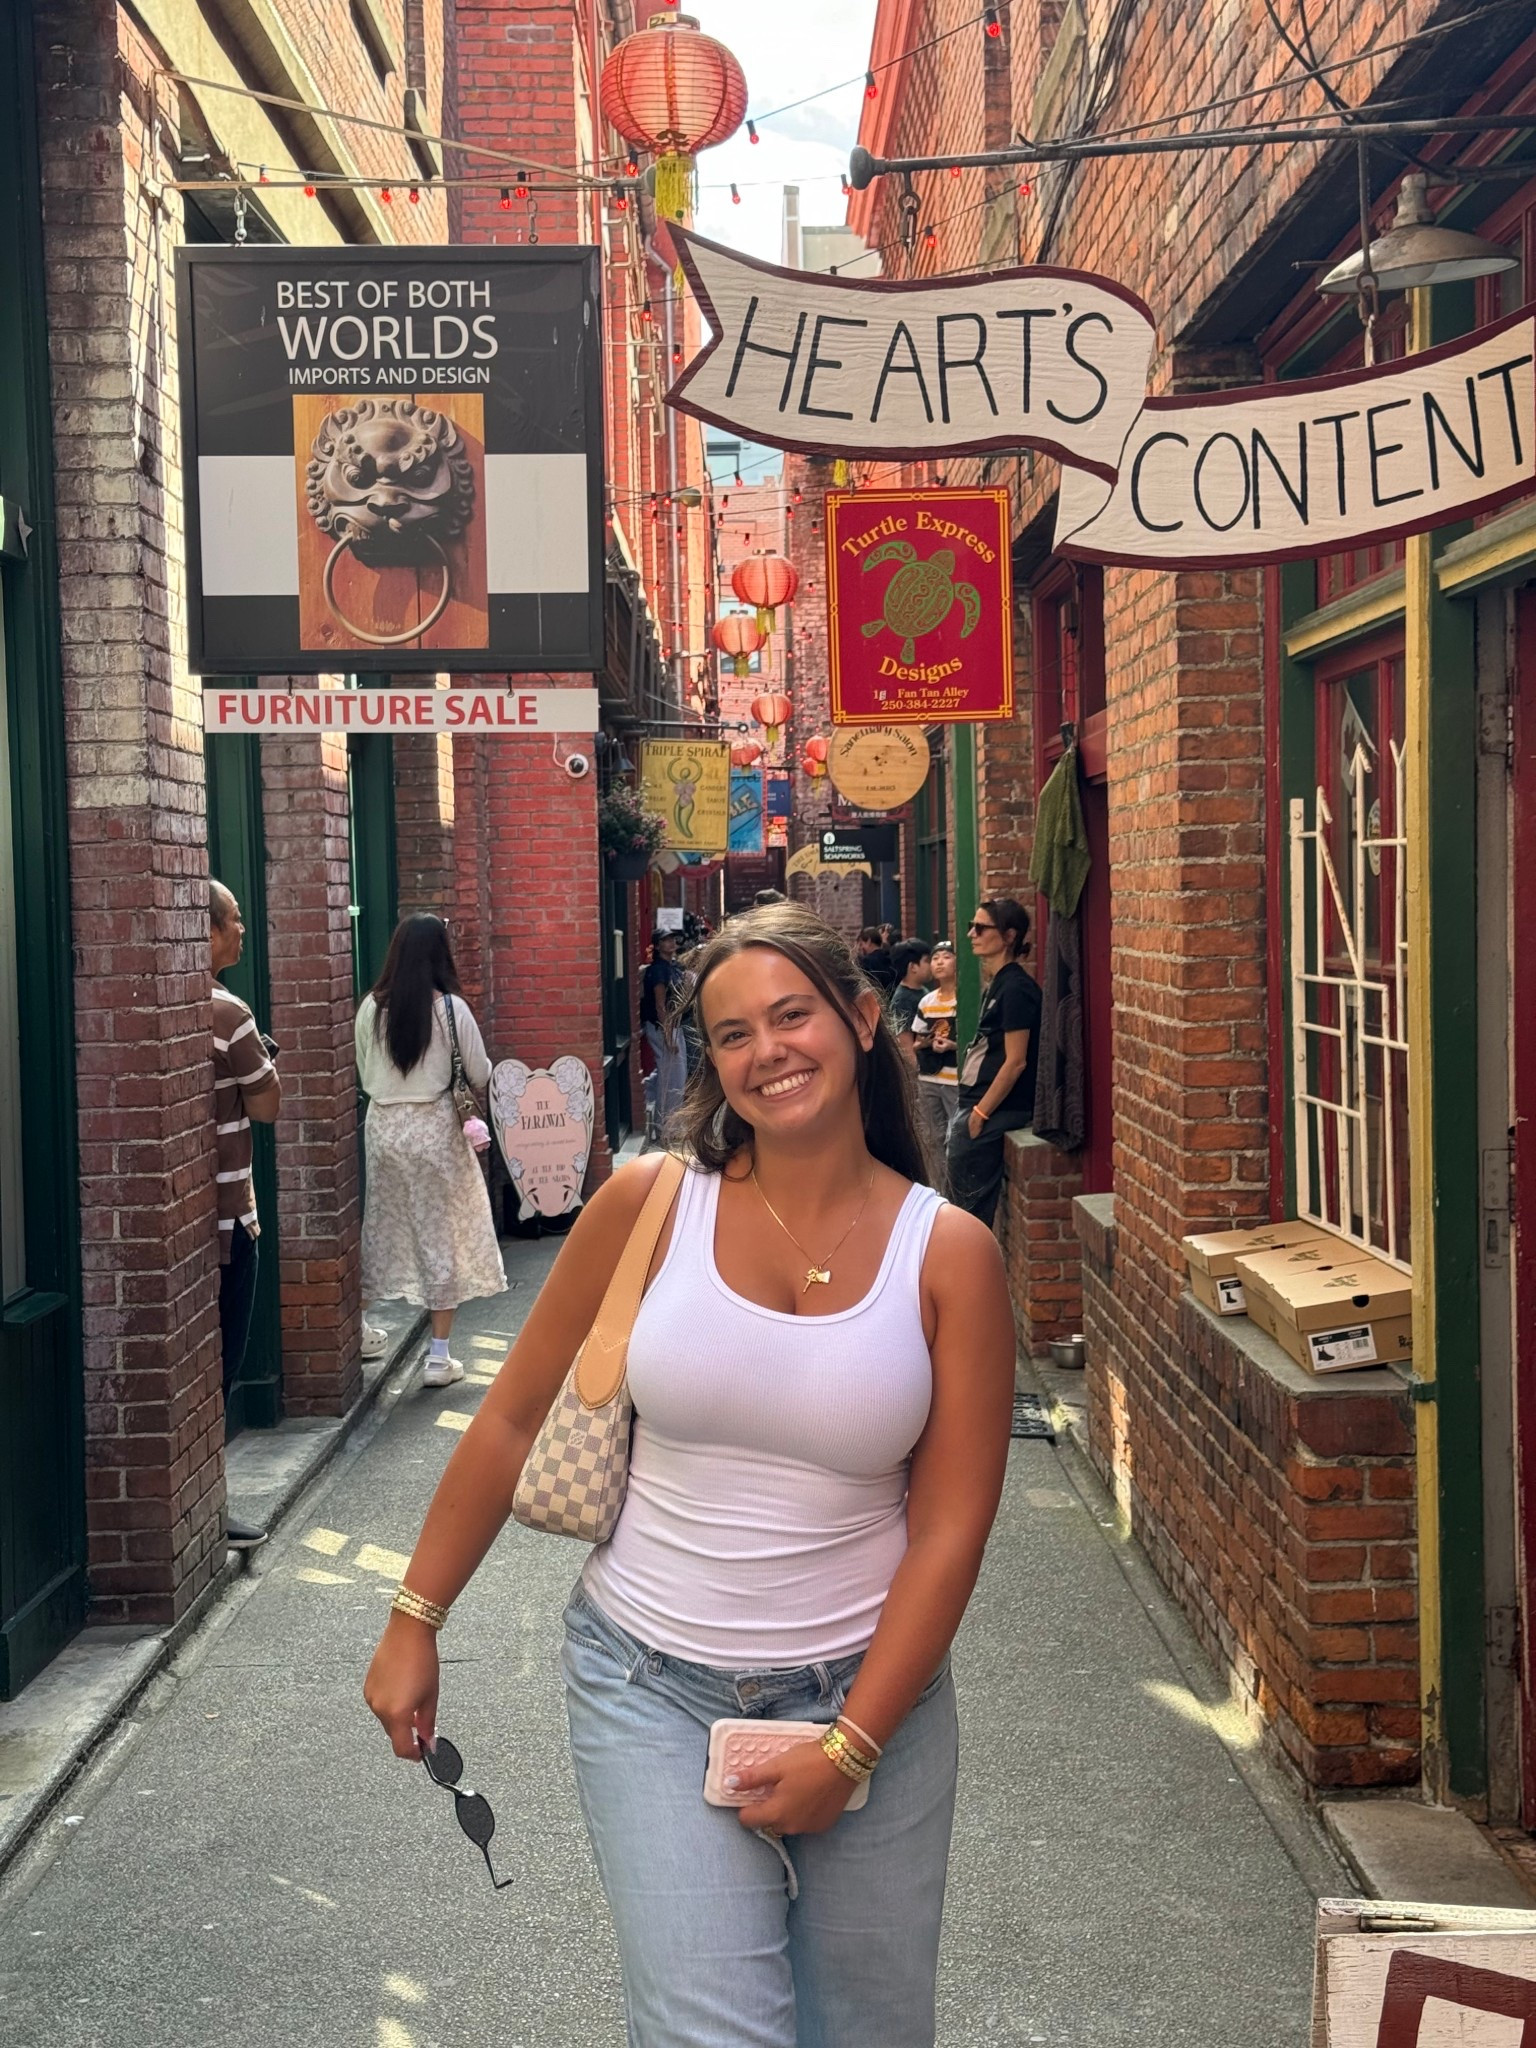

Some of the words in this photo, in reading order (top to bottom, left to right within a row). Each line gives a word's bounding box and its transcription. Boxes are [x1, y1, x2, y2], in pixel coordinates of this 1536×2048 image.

[277, 281, 349, 309] BEST
[357, 281, 398, 309] OF
[408, 281, 490, 308] BOTH
[278, 315, 499, 360] WORLDS
[725, 296, 1113, 425] HEART'S
[289, 367, 371, 385] IMPORTS
[376, 367, 417, 384] AND
[422, 367, 490, 384] DESIGN
[1130, 354, 1533, 532] CONTENT
[841, 516, 908, 558] Turtle
[915, 511, 996, 564] Express
[878, 656, 963, 684] Designs
[881, 698, 960, 711] 250-384-2227
[897, 688, 917, 699] Fan
[919, 687, 940, 698] Tan
[942, 687, 969, 699] Alley
[218, 694, 434, 725] FURNITURE
[445, 694, 538, 726] SALE
[645, 745, 683, 757] TRIPLE
[686, 746, 727, 758] SPIRAL
[893, 728, 918, 757] Salon
